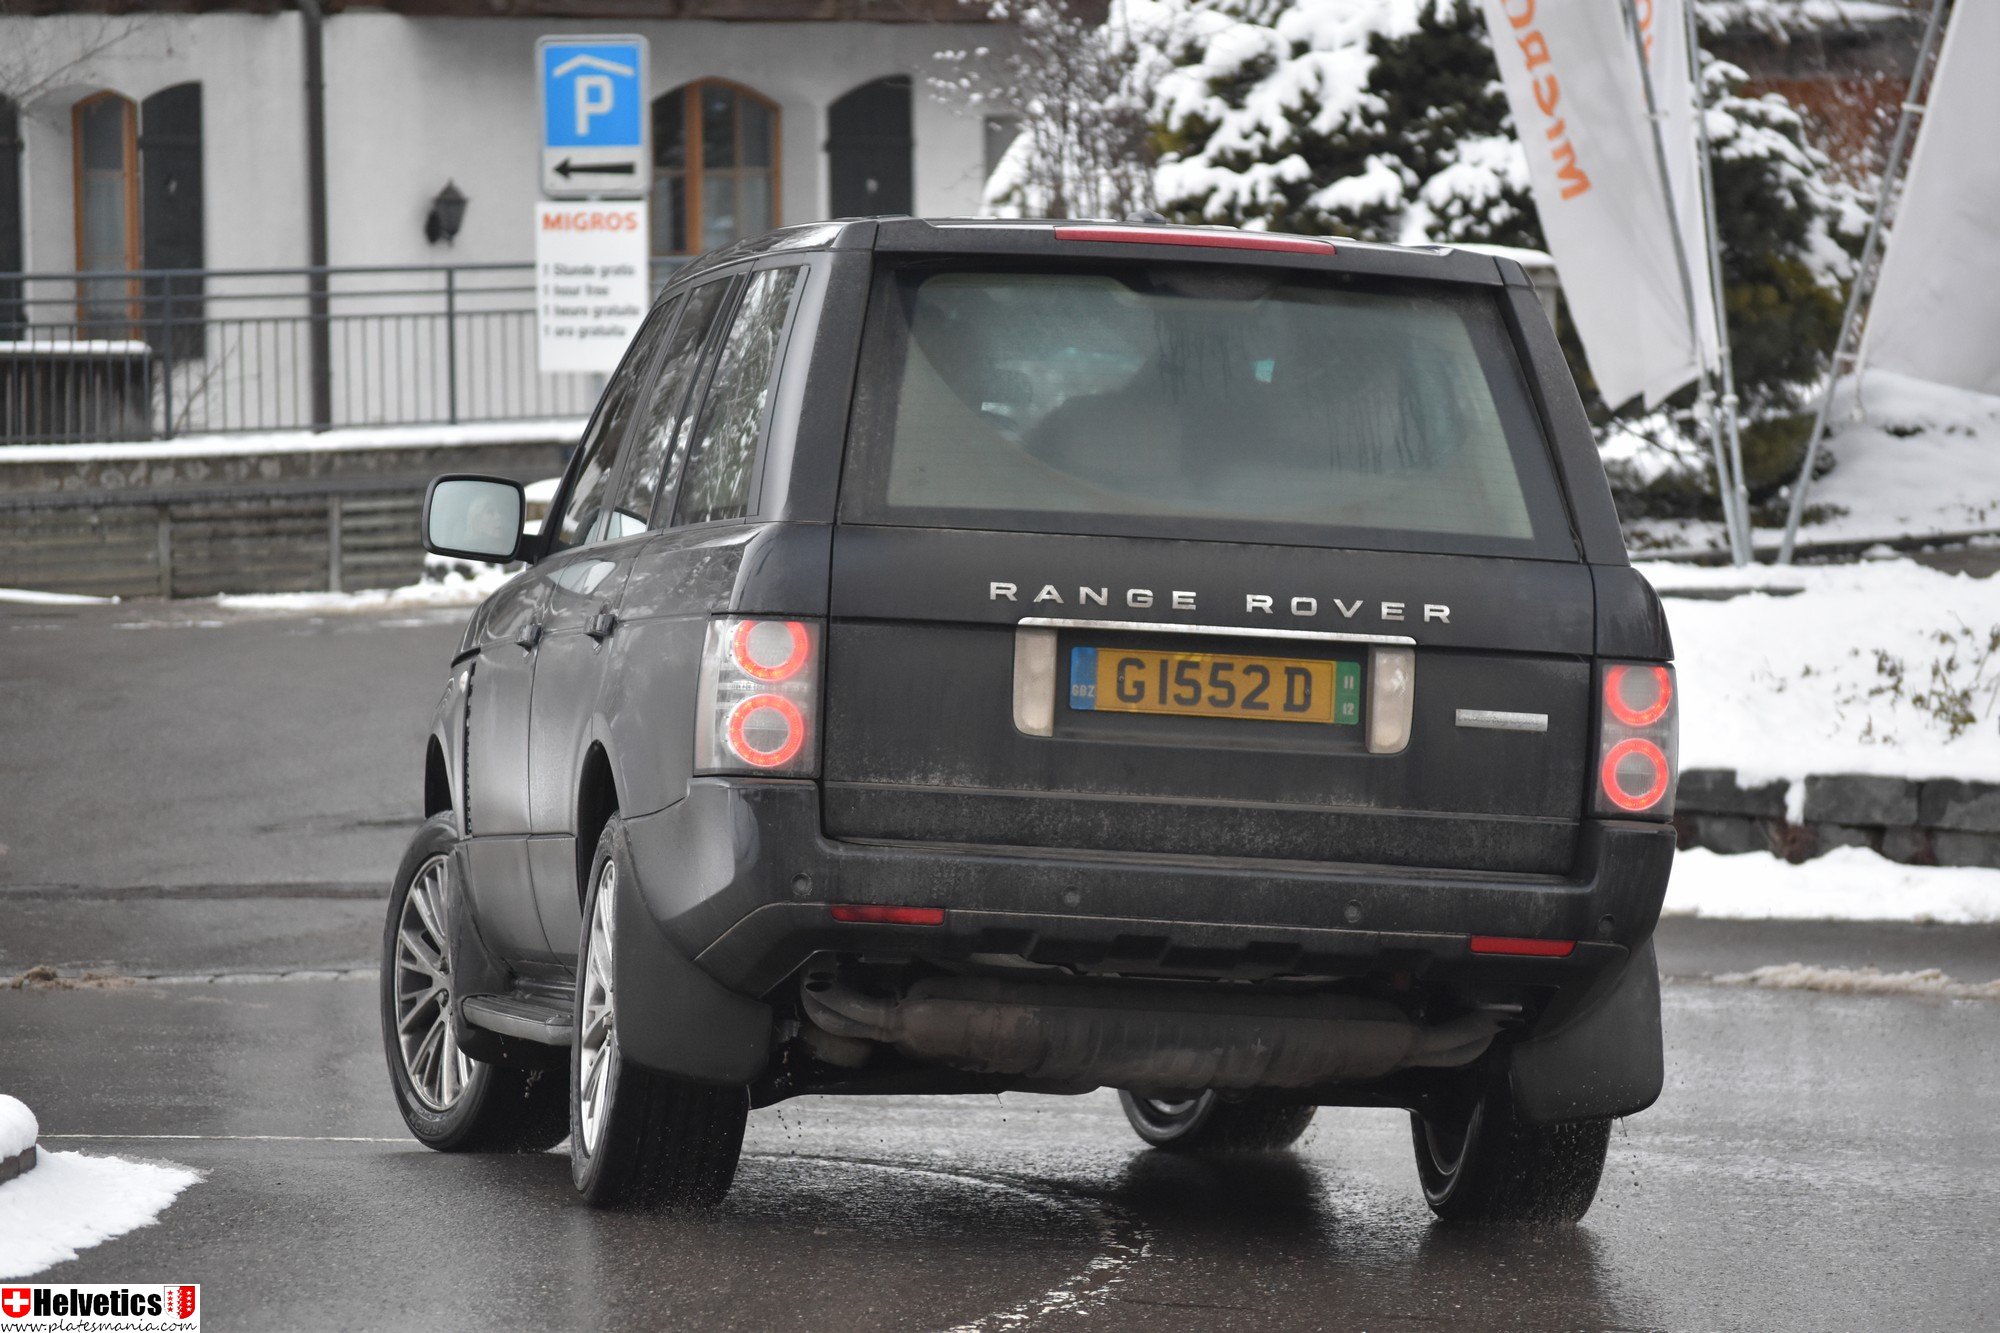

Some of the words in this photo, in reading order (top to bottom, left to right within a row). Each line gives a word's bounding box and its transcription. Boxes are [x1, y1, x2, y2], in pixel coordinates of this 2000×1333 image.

[575, 75, 615, 137] P
[542, 211, 639, 231] MIGROS
[989, 581, 1198, 611] RANGE
[1245, 593, 1452, 624] ROVER
